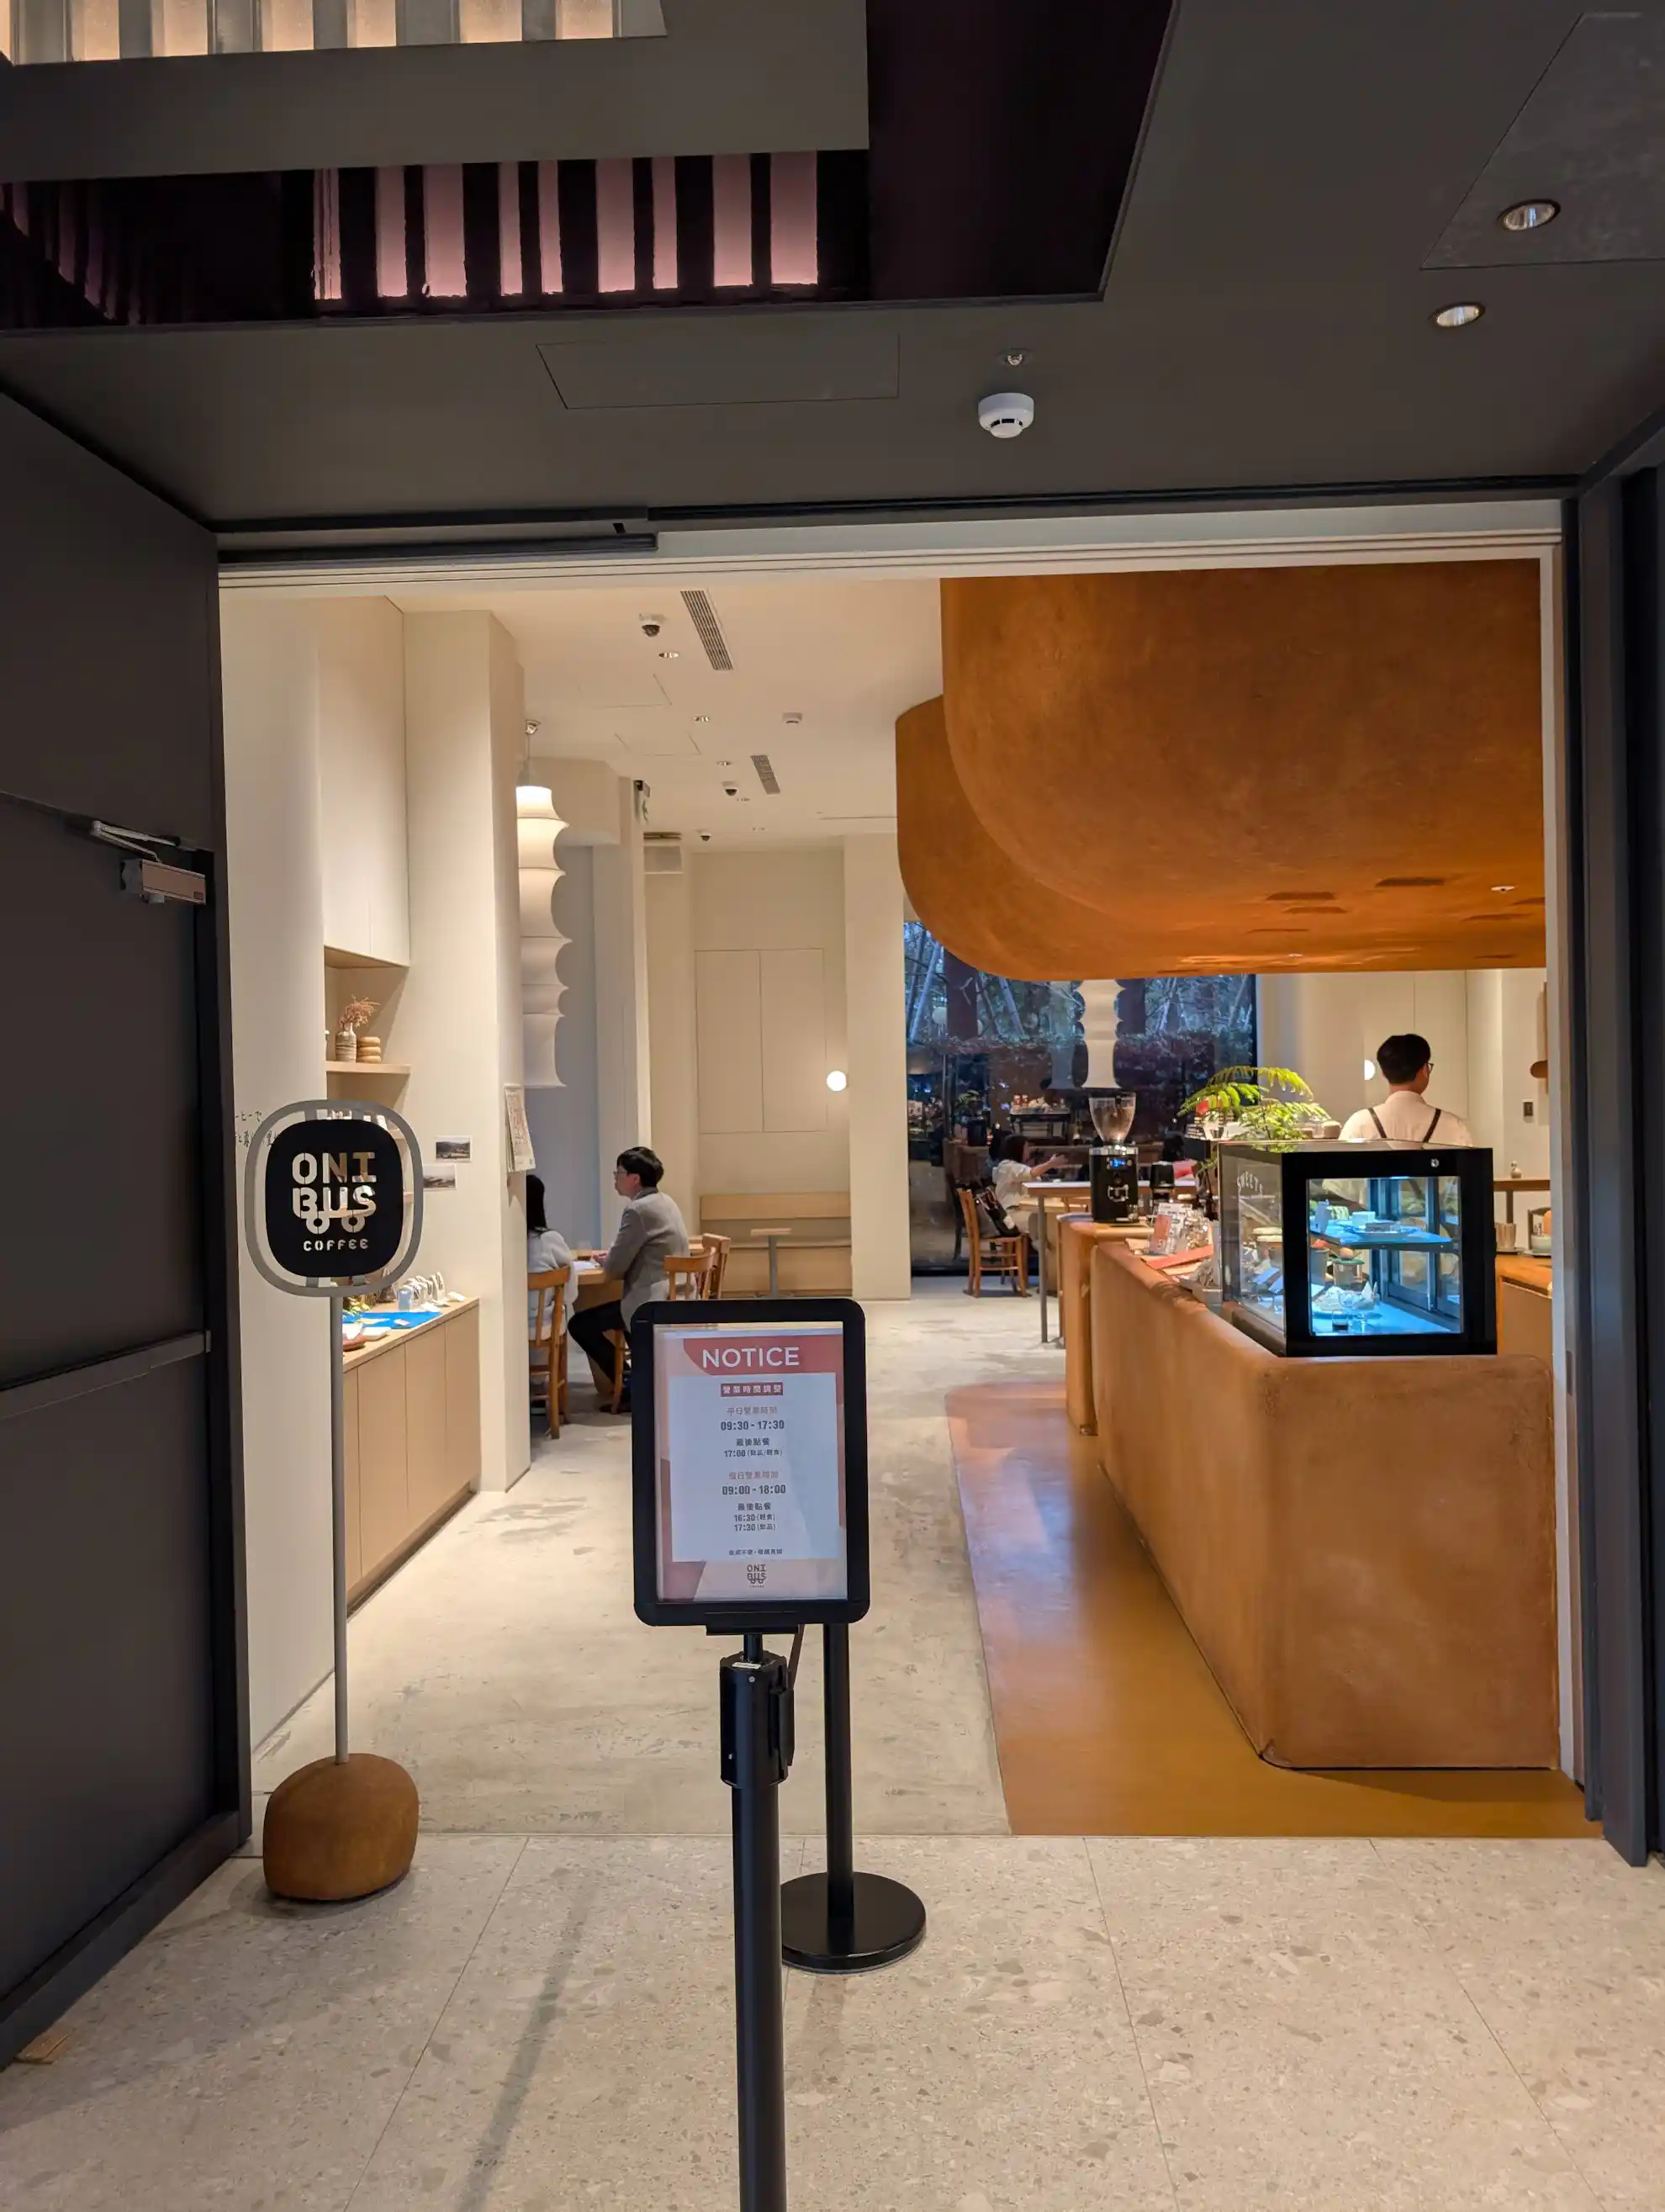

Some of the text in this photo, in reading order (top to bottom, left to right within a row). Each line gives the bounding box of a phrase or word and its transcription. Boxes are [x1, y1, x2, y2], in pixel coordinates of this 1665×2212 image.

[292, 1151, 376, 1185] ONI
[292, 1185, 377, 1224] BUS
[303, 1238, 369, 1252] COFFEE
[702, 1346, 800, 1368] NOTICE
[721, 1421, 749, 1431] 09:30
[758, 1420, 785, 1430] 17:30
[722, 1485, 750, 1495] 09:00
[759, 1484, 786, 1495] 18:00
[747, 1564, 766, 1573] ONI
